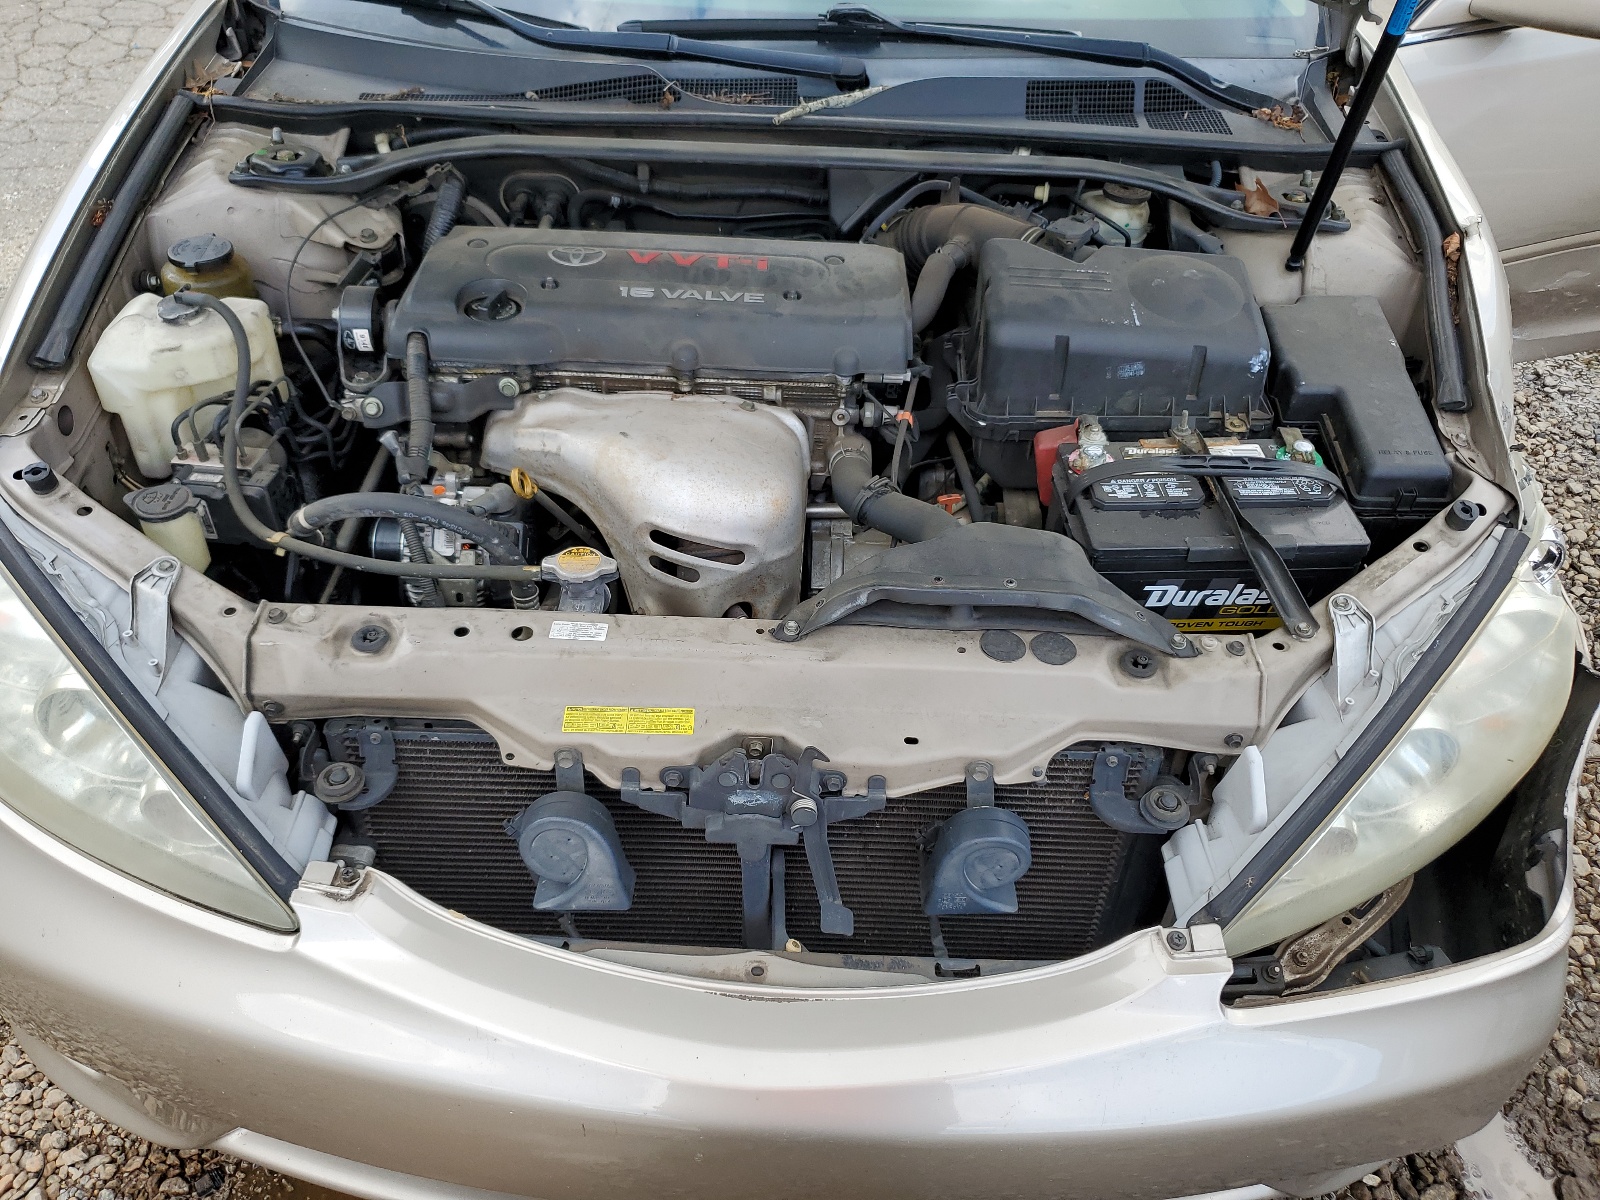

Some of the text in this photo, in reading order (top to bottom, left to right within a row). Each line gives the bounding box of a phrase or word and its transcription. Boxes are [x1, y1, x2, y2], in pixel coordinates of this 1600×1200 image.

[619, 286, 765, 303] 16 VALVE
[1127, 446, 1177, 455] Duralast
[1143, 583, 1271, 607] Duralas
